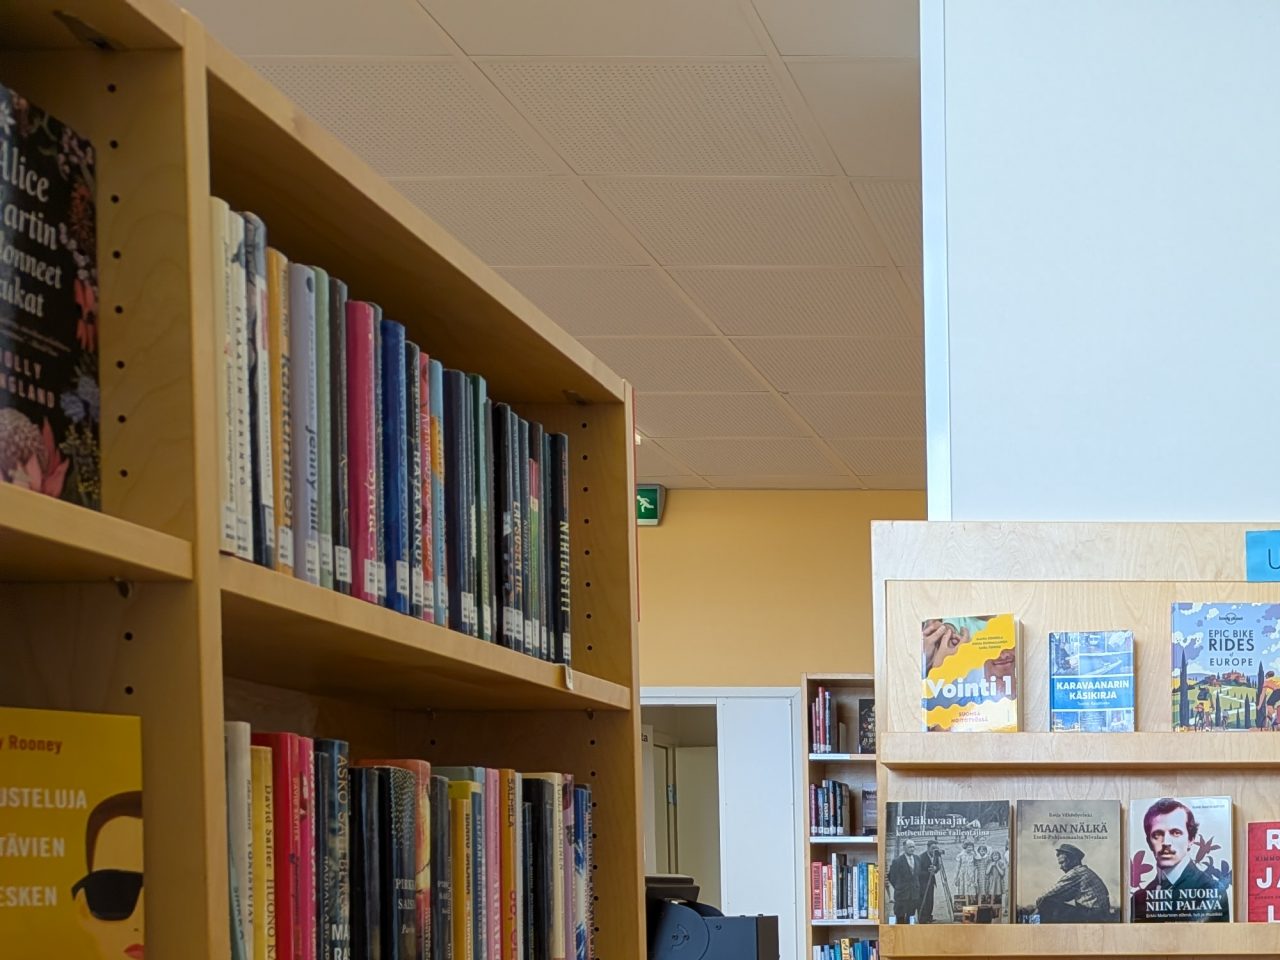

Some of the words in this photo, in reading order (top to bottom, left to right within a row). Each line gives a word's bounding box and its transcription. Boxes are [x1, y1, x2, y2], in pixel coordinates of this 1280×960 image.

[304, 424, 319, 491] jenny
[559, 520, 572, 615] NIHILISTIT
[1208, 629, 1229, 638] EPIC
[1232, 629, 1254, 638] BIKE
[1208, 638, 1255, 651] RIDES
[1209, 657, 1253, 667] EUROPE
[926, 676, 997, 698] Vointi
[1003, 675, 1012, 696] 1
[1056, 680, 1130, 690] KARAVAANARIN
[1069, 690, 1118, 700] KÄSIKIRJA
[9, 734, 64, 755] Rooney
[337, 753, 350, 804] ASKO
[896, 815, 967, 828] Kyläkuvaajat
[1033, 822, 1068, 833] MAAN
[1069, 821, 1108, 834] NÄLKÄ
[1146, 889, 1173, 900] NIIN
[1179, 888, 1222, 900] NUORI,
[266, 878, 276, 938] HUONO
[1146, 900, 1173, 912] NIIN
[1175, 900, 1222, 911] PALAVA
